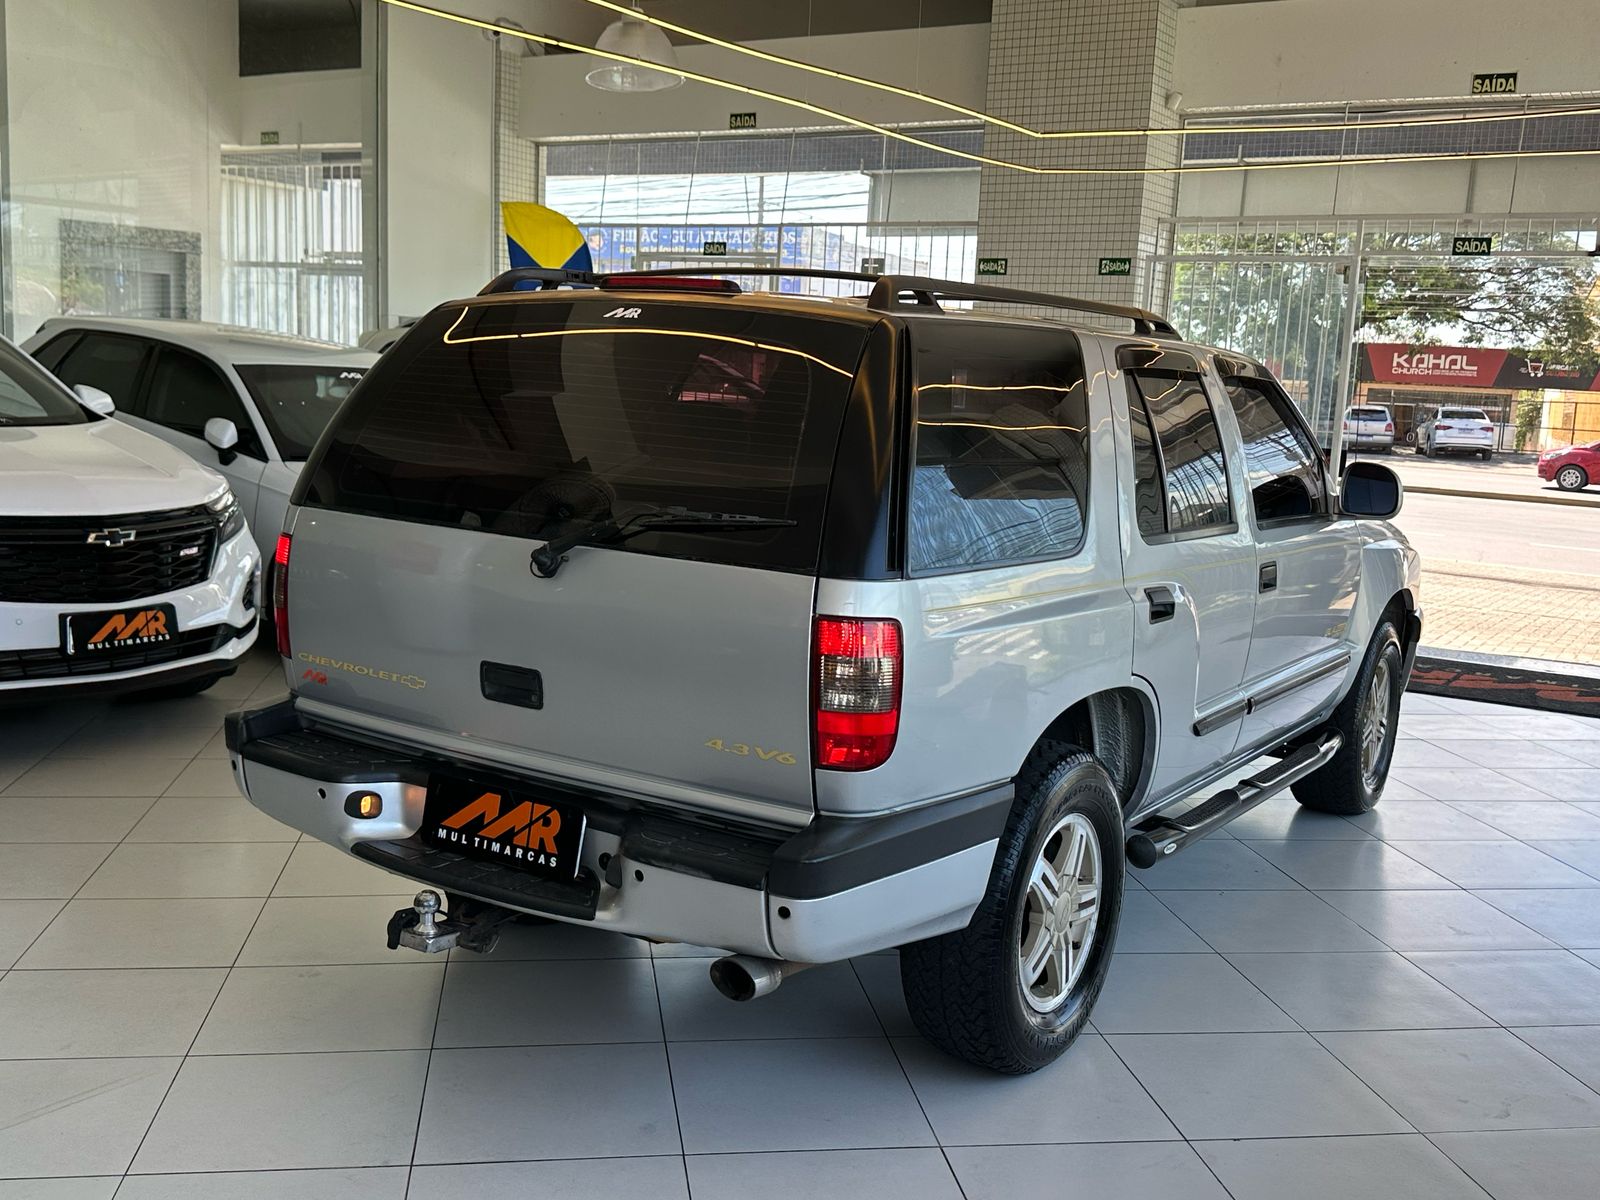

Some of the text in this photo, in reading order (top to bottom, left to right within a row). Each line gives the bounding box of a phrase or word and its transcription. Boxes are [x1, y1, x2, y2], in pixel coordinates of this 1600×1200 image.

[1472, 74, 1515, 93] SAÍDA
[730, 113, 756, 128] SAÍDA
[1454, 238, 1489, 253] SAÍDA
[1392, 352, 1478, 371] KAHAL
[1391, 367, 1433, 376] CHURCH
[87, 633, 171, 651] MULTIMARCAS
[297, 652, 401, 682] CHEVROLET
[754, 746, 798, 766] V6
[437, 828, 558, 868] MULTIMARCAS
